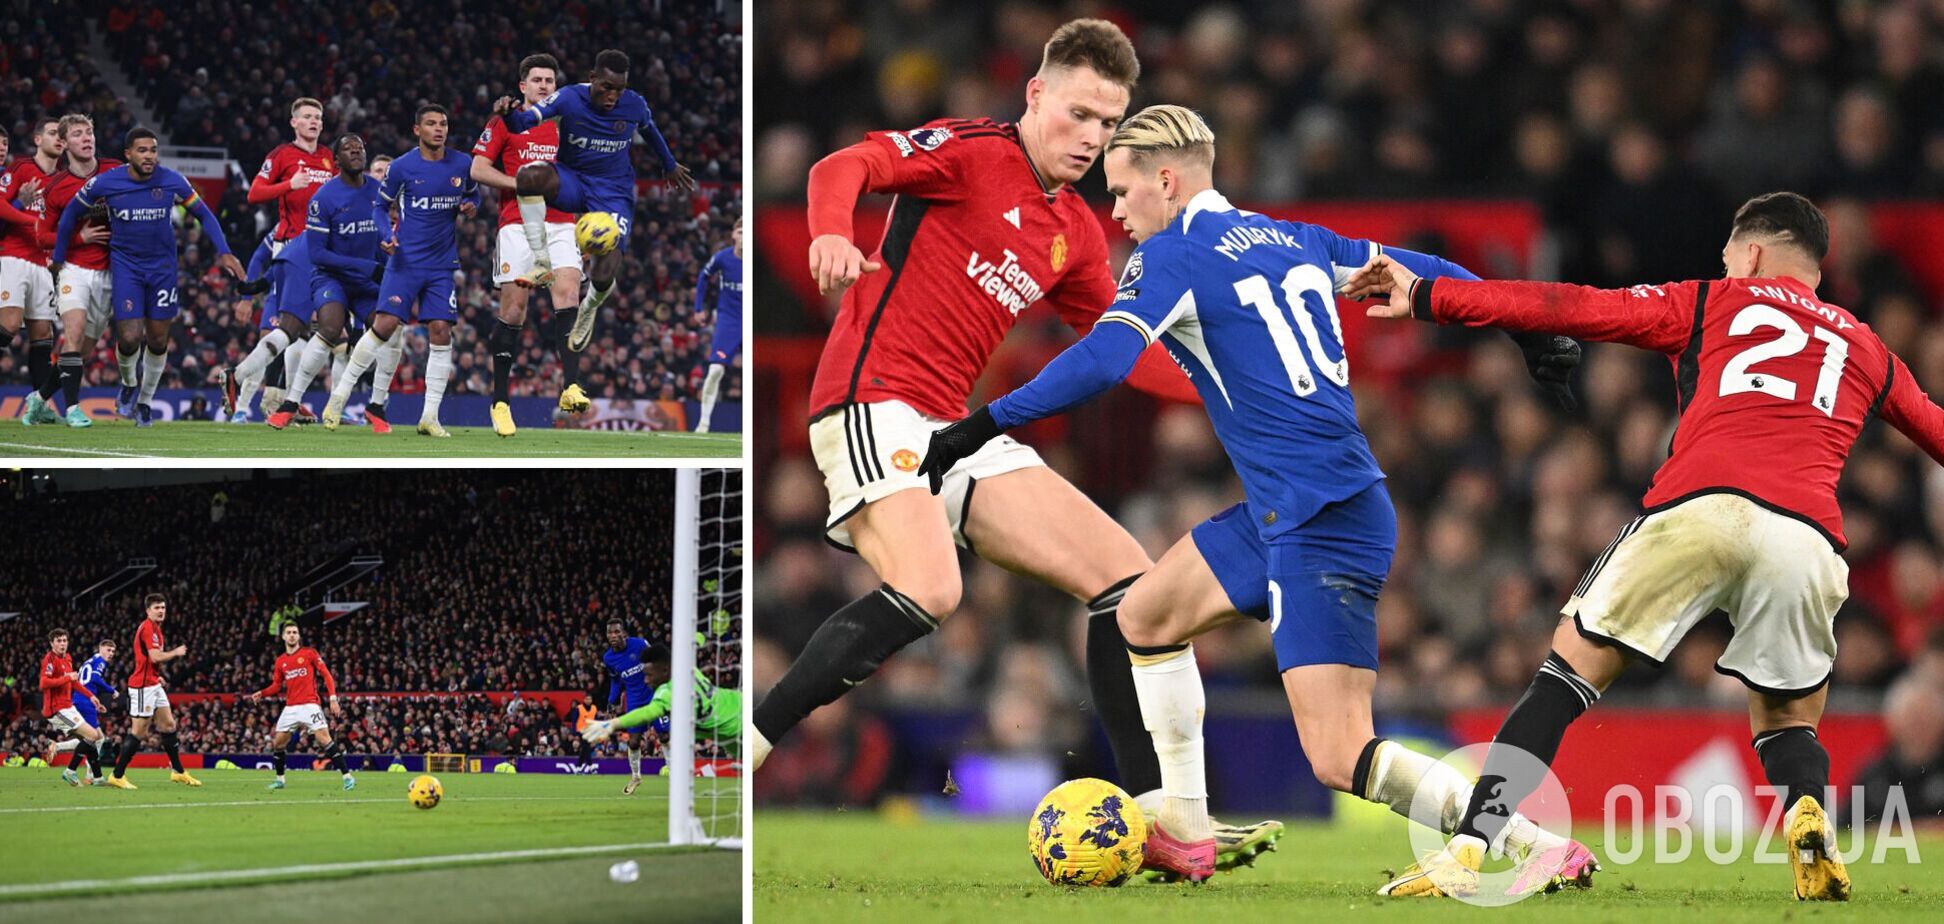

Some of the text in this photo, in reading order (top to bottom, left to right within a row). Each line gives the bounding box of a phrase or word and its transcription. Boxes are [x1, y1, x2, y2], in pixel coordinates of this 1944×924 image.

[518, 149, 557, 160] Viewer
[526, 141, 559, 152] Team
[997, 248, 1044, 308] Team
[1232, 263, 1349, 397] 10
[1748, 285, 1854, 330] ANTONY
[1718, 303, 1849, 418] 21
